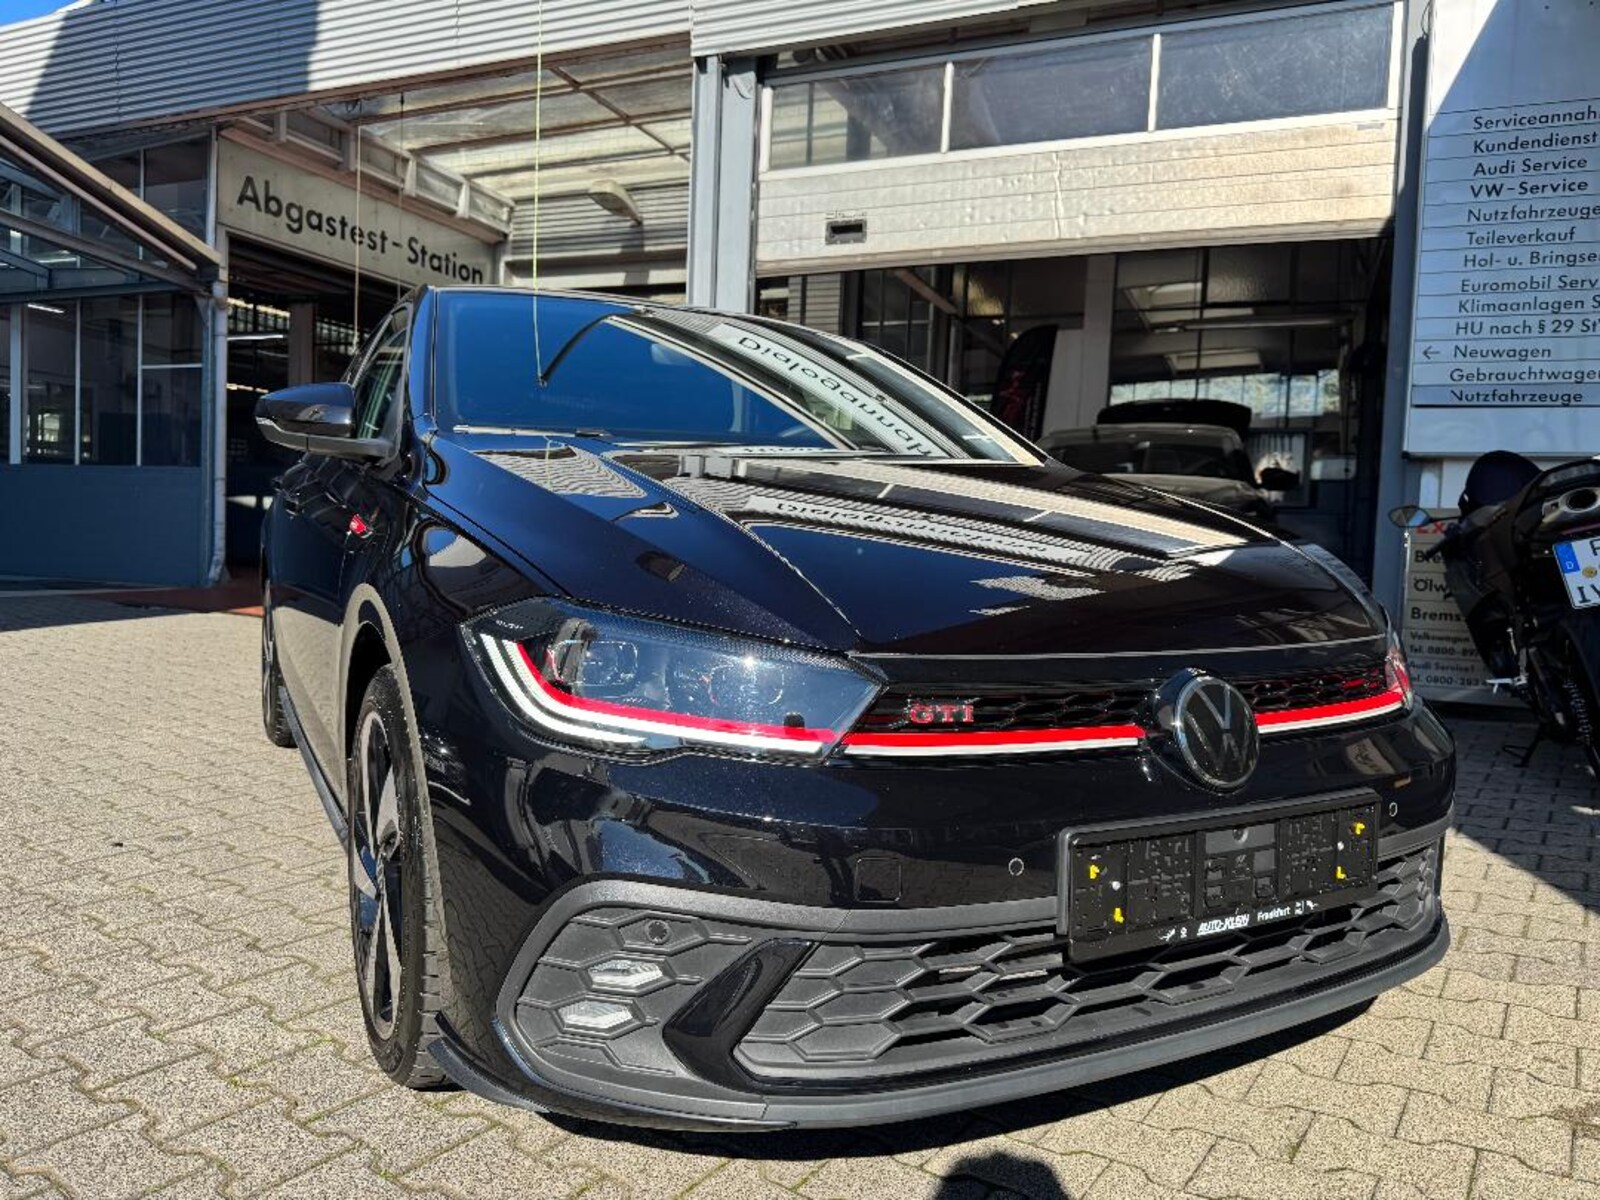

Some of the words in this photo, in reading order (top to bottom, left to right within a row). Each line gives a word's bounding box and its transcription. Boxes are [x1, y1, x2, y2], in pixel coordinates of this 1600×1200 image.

[1473, 105, 1600, 130] Serviceannah
[1473, 131, 1597, 154] Kundendienst
[1473, 160, 1515, 177] Audi
[1522, 156, 1588, 173] Service
[1470, 178, 1589, 198] VW-Service
[1467, 204, 1600, 223] Nutzfahrzeuge
[1466, 226, 1577, 246] Teileverkauf
[1464, 253, 1500, 268] Hol-
[1507, 256, 1523, 266] u.
[1530, 251, 1600, 267] Bringse
[1461, 275, 1551, 293] Euromobil
[1557, 274, 1599, 289] Serv
[1458, 296, 1585, 314] Klimaanlagen
[1455, 321, 1483, 336] HU
[1489, 319, 1532, 335] nach
[1538, 319, 1546, 334] §
[1551, 319, 1574, 333] 29
[1580, 318, 1600, 333] St
[1453, 344, 1551, 361] Neuwagen
[1451, 388, 1583, 406] Nutzfahrzeuge
[1565, 561, 1574, 570] D
[909, 703, 975, 724] GTI
